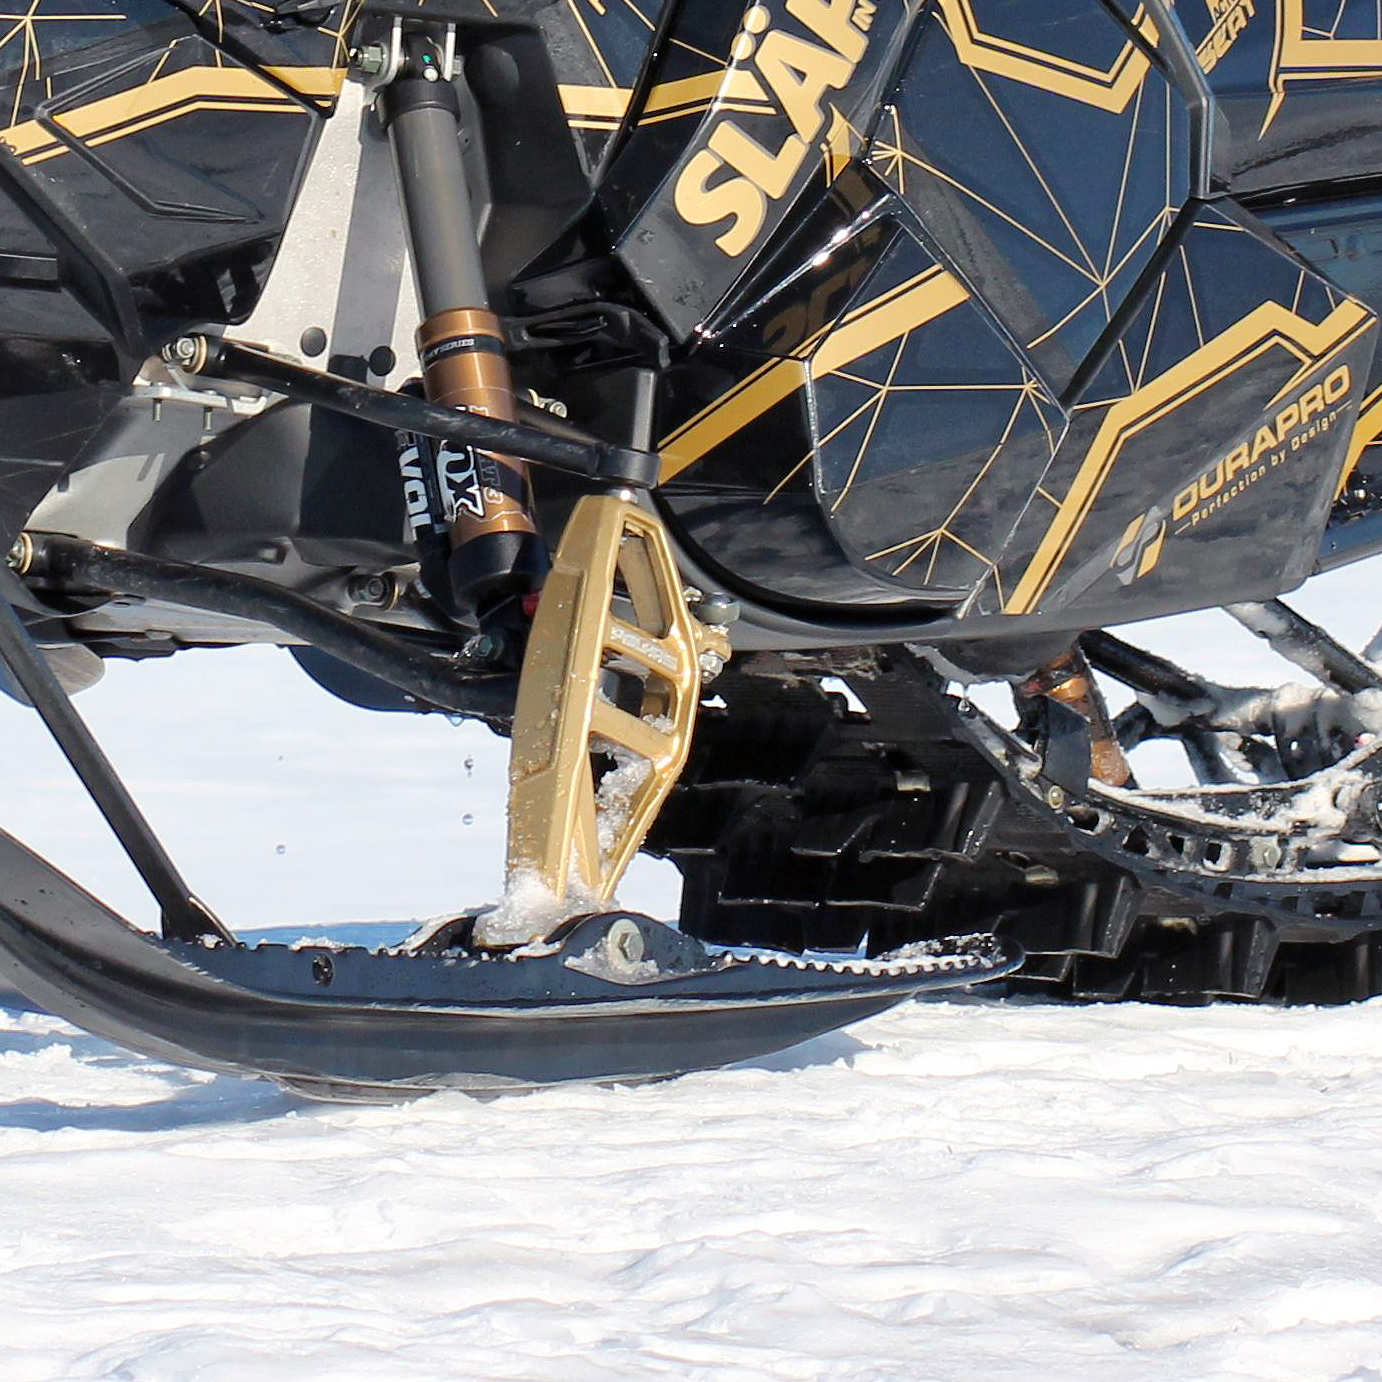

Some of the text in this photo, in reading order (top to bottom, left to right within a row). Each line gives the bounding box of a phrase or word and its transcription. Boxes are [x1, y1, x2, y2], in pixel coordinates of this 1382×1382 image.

[1171, 362, 1352, 523] DURAPRO
[1190, 410, 1338, 527] Perfection by Design
